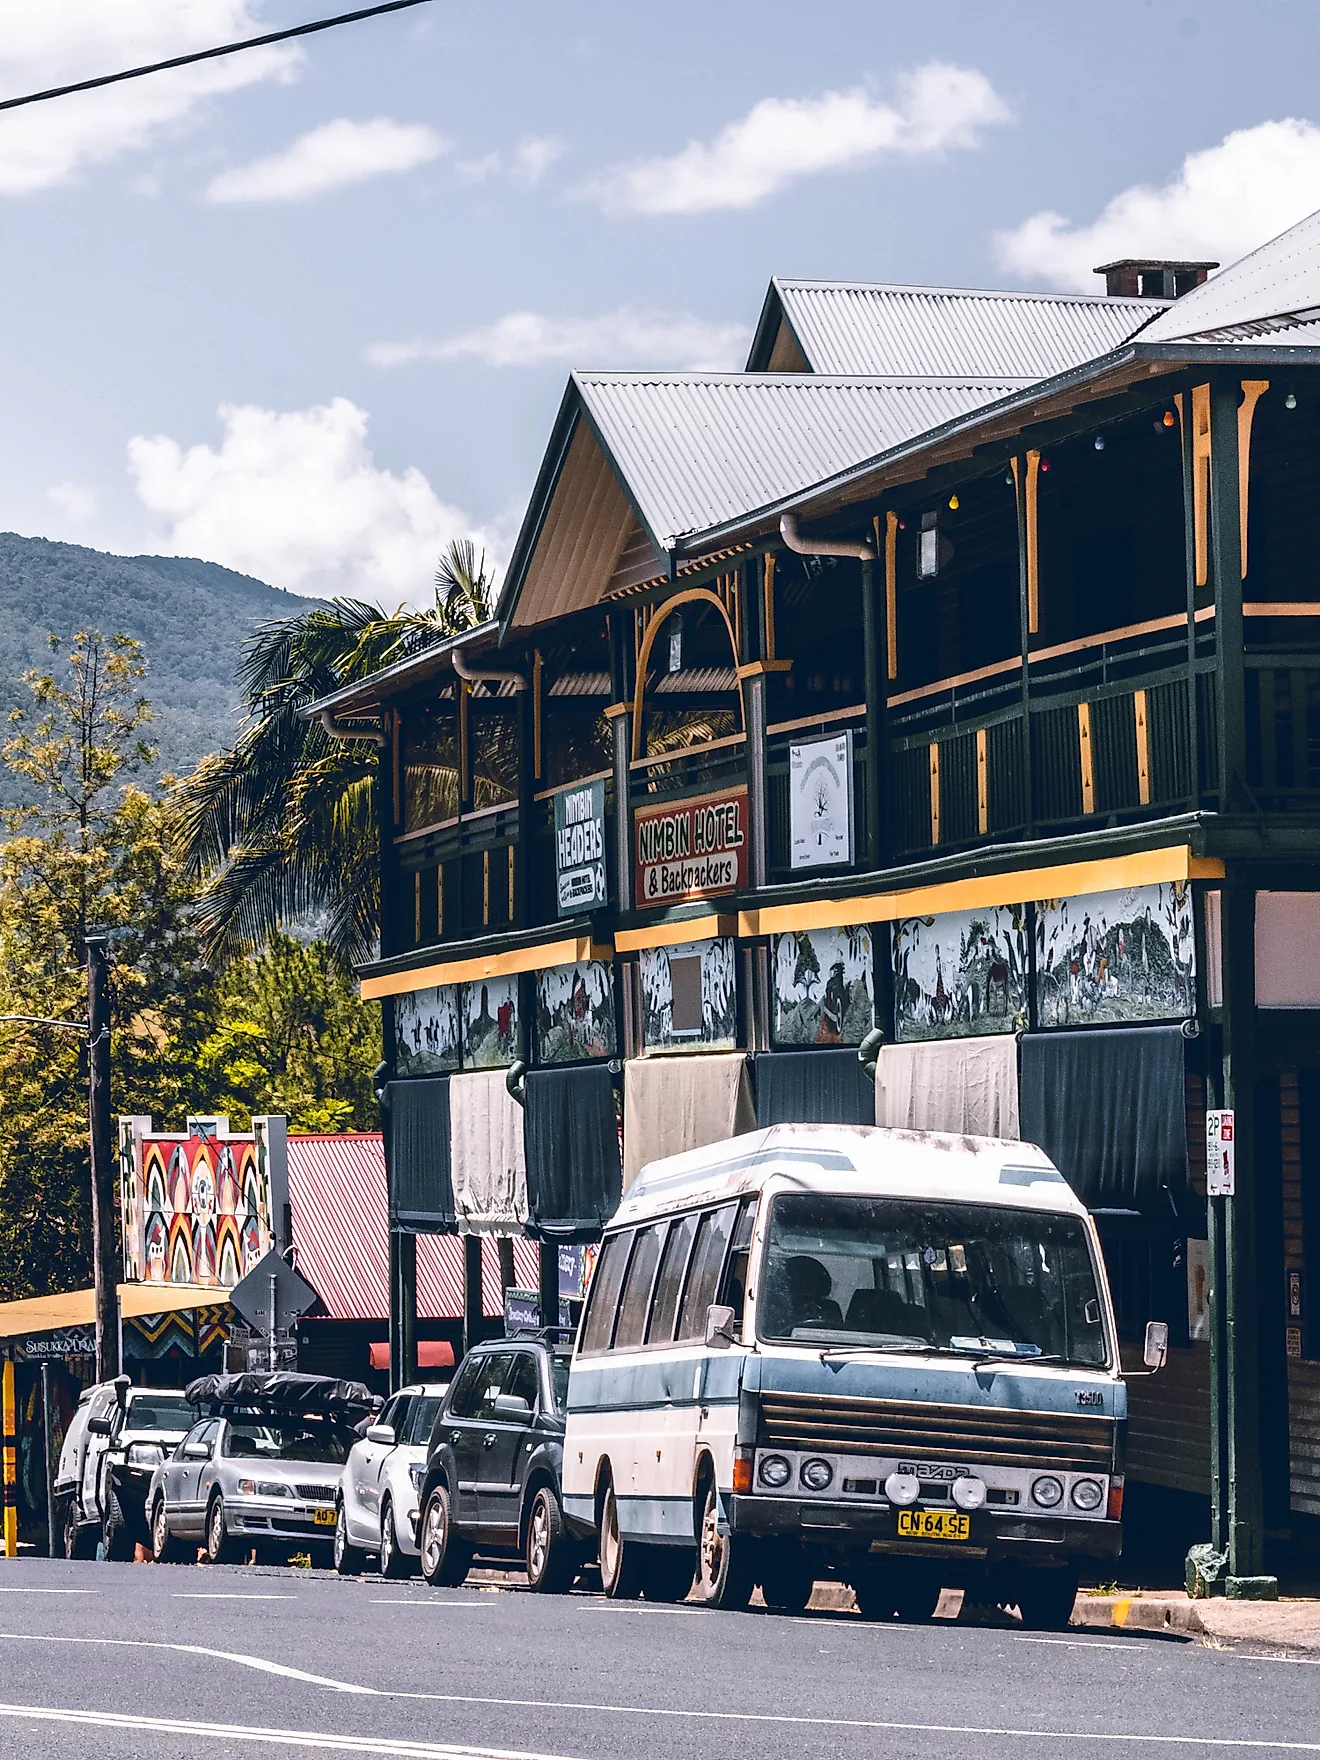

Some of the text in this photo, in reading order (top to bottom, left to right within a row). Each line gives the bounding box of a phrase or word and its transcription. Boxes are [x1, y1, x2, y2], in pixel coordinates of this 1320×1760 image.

[565, 788, 593, 826] NIMBIN
[558, 818, 603, 869] HEADERS
[639, 800, 744, 866] NIMBIN HOTEL
[648, 857, 732, 897] & Backpackers
[25, 1338, 97, 1354] SUSUKKA TRA
